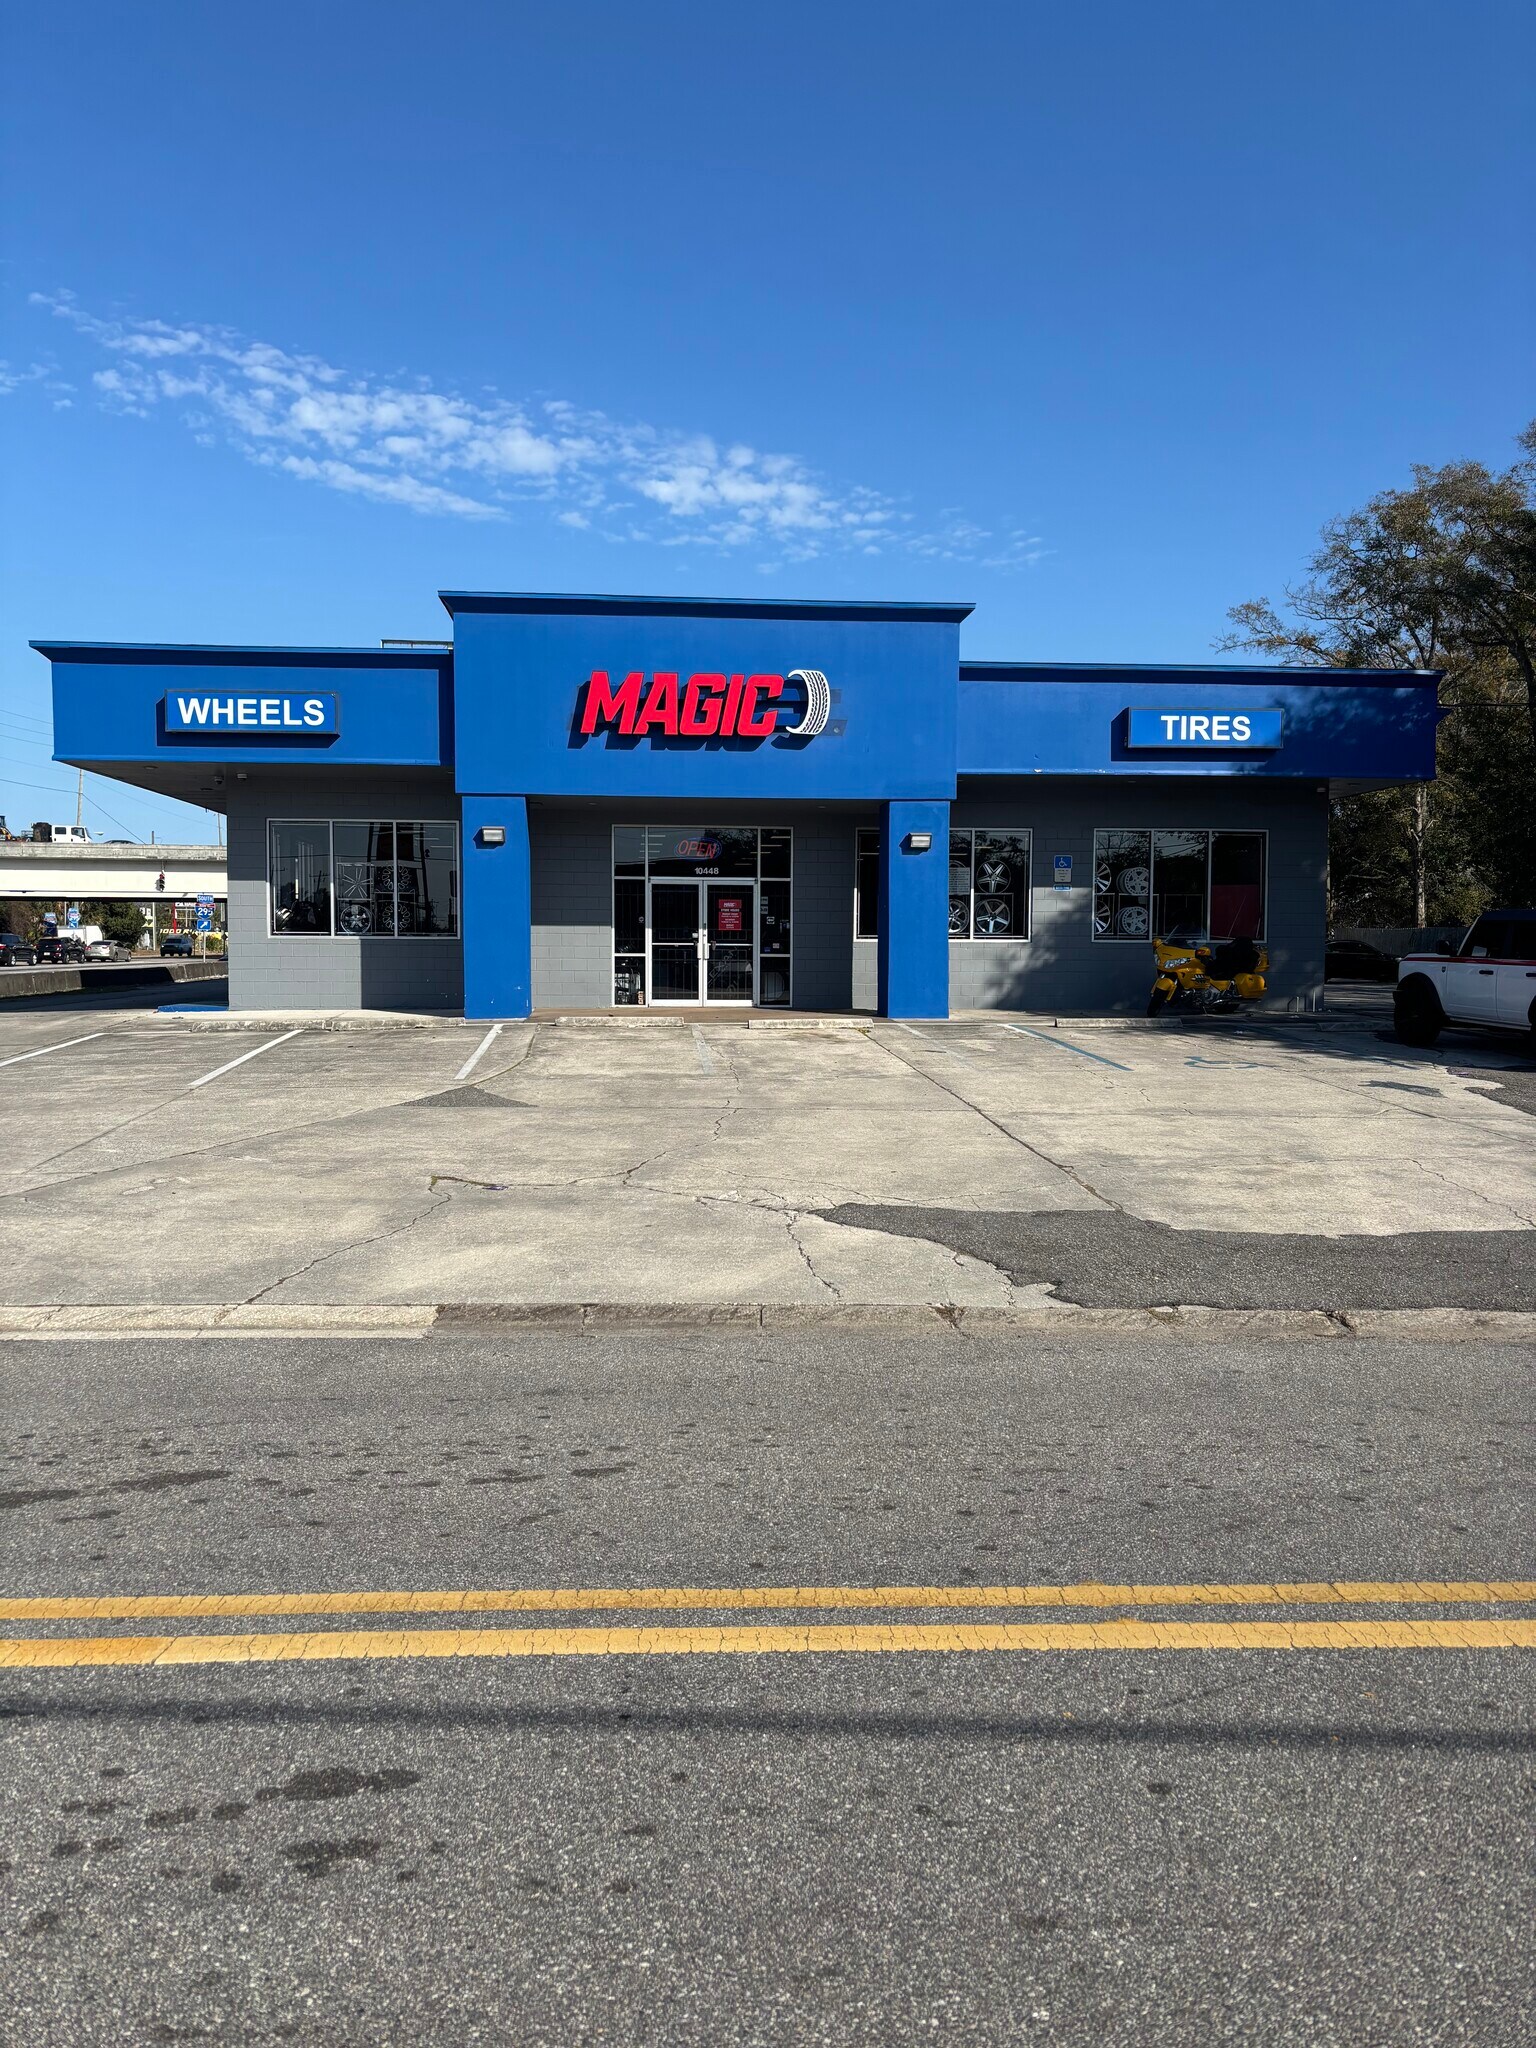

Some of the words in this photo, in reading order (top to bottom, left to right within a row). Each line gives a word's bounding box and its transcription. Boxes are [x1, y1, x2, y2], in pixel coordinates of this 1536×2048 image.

[177, 697, 325, 726] WHEELS
[580, 670, 784, 736] MAGIC
[1160, 715, 1251, 741] TIRES
[677, 839, 717, 859] OPEN
[694, 867, 719, 875] 10448
[197, 907, 213, 916] 295
